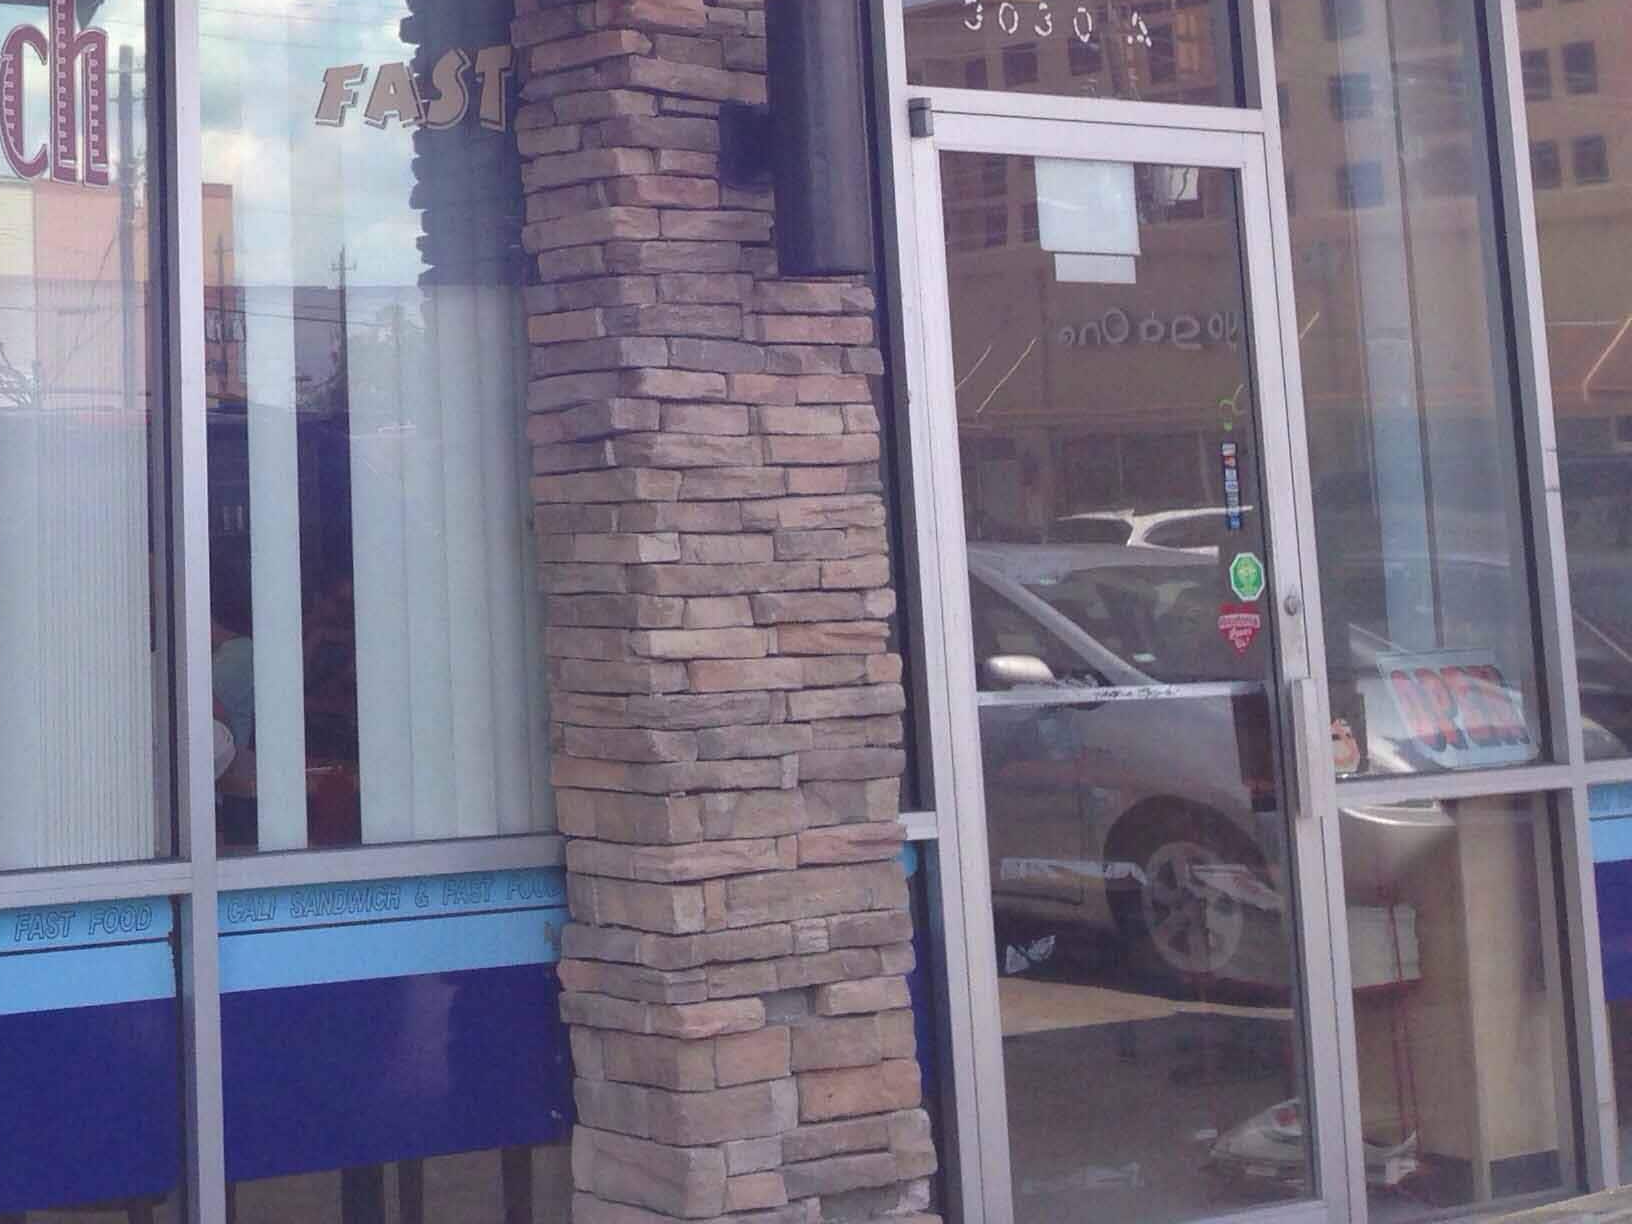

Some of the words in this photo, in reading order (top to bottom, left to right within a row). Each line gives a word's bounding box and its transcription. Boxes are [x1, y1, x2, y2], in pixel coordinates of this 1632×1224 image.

[314, 43, 514, 132] FAST
[14, 909, 78, 942] FAST
[88, 904, 153, 936] FOOD
[226, 896, 277, 923] CALI
[288, 885, 402, 918] SANDWICH
[442, 877, 497, 906] FAST
